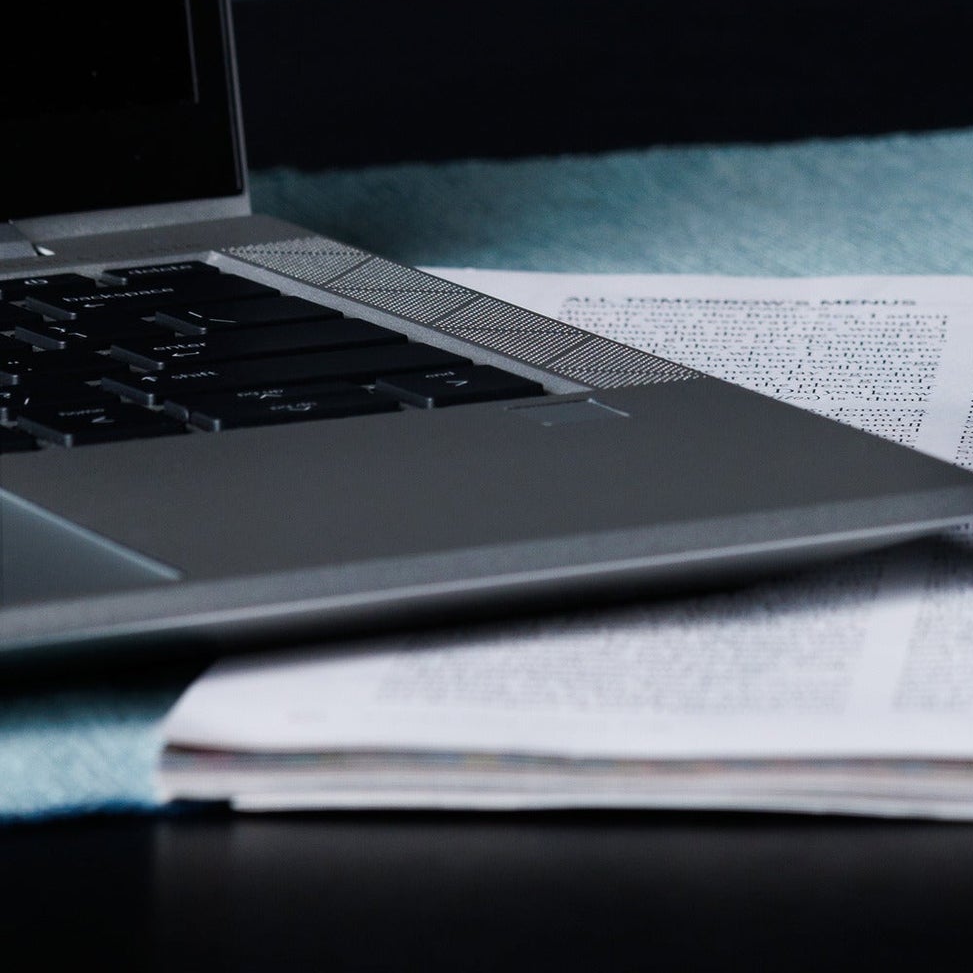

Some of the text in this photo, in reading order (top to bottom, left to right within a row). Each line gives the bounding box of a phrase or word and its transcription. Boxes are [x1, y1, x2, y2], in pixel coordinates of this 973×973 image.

[127, 264, 193, 275] delete
[62, 286, 175, 304] backspace
[621, 296, 810, 305] TOMORROW'S
[819, 298, 917, 306] MENUS
[152, 341, 207, 351] enter
[170, 370, 219, 380] shift
